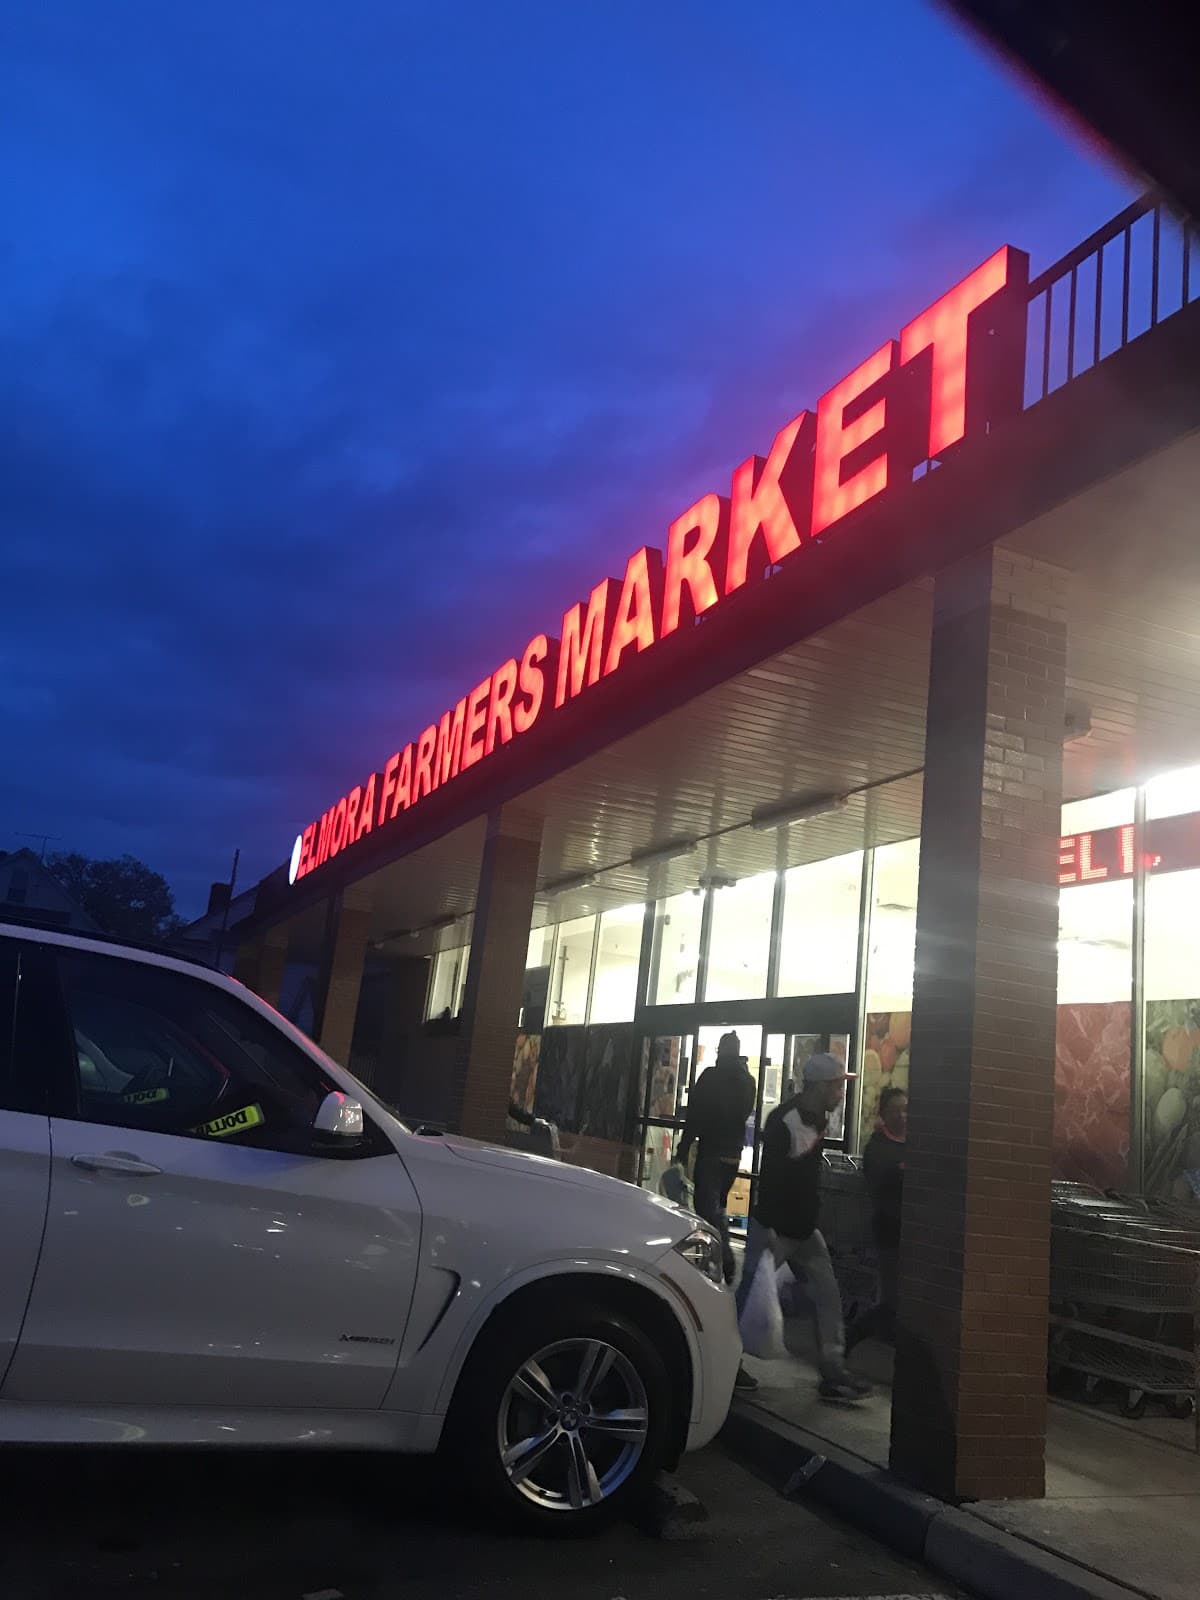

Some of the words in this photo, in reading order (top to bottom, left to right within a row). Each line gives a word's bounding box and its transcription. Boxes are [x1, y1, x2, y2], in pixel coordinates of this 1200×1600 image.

[297, 772, 376, 880] ELMORA
[378, 633, 548, 826] FARMERS
[555, 244, 1008, 709] MARKET
